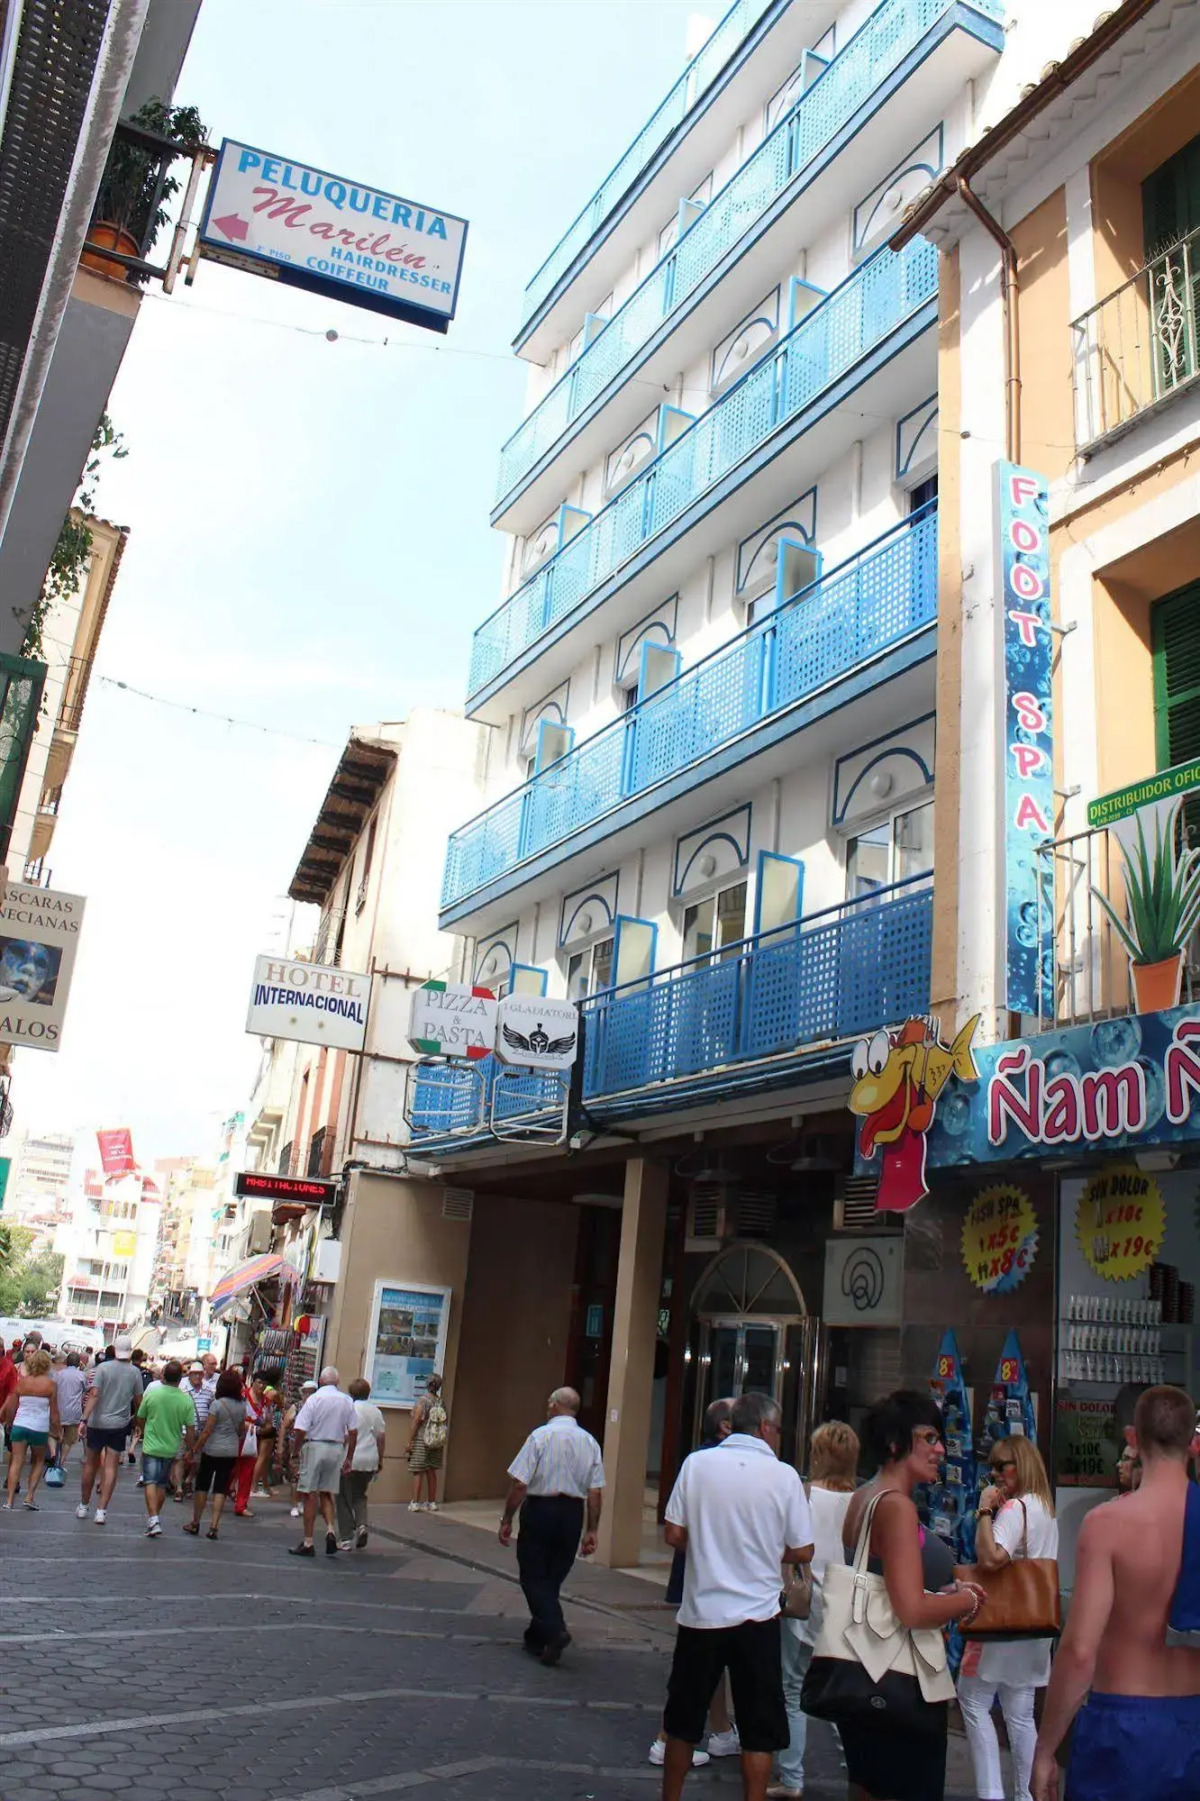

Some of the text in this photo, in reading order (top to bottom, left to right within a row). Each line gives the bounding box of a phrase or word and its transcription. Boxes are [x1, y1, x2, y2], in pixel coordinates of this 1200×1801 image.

[237, 150, 448, 240] PELUQUERIA
[252, 187, 426, 269] Marilén
[306, 256, 390, 291] COIFFEUR
[330, 246, 451, 294] HAIRDRESSER
[1010, 476, 1048, 832] FOOT SPA
[1090, 777, 1172, 820] DISTRIBUIDOR
[265, 963, 361, 998] HOTEL
[254, 984, 363, 1025] INTERNACIONAL
[425, 990, 488, 1016] PIZZA
[453, 1015, 461, 1025] &
[423, 1022, 487, 1048] PASTA
[988, 1044, 1146, 1145] Ñam
[1056, 1399, 1076, 1412] SIN
